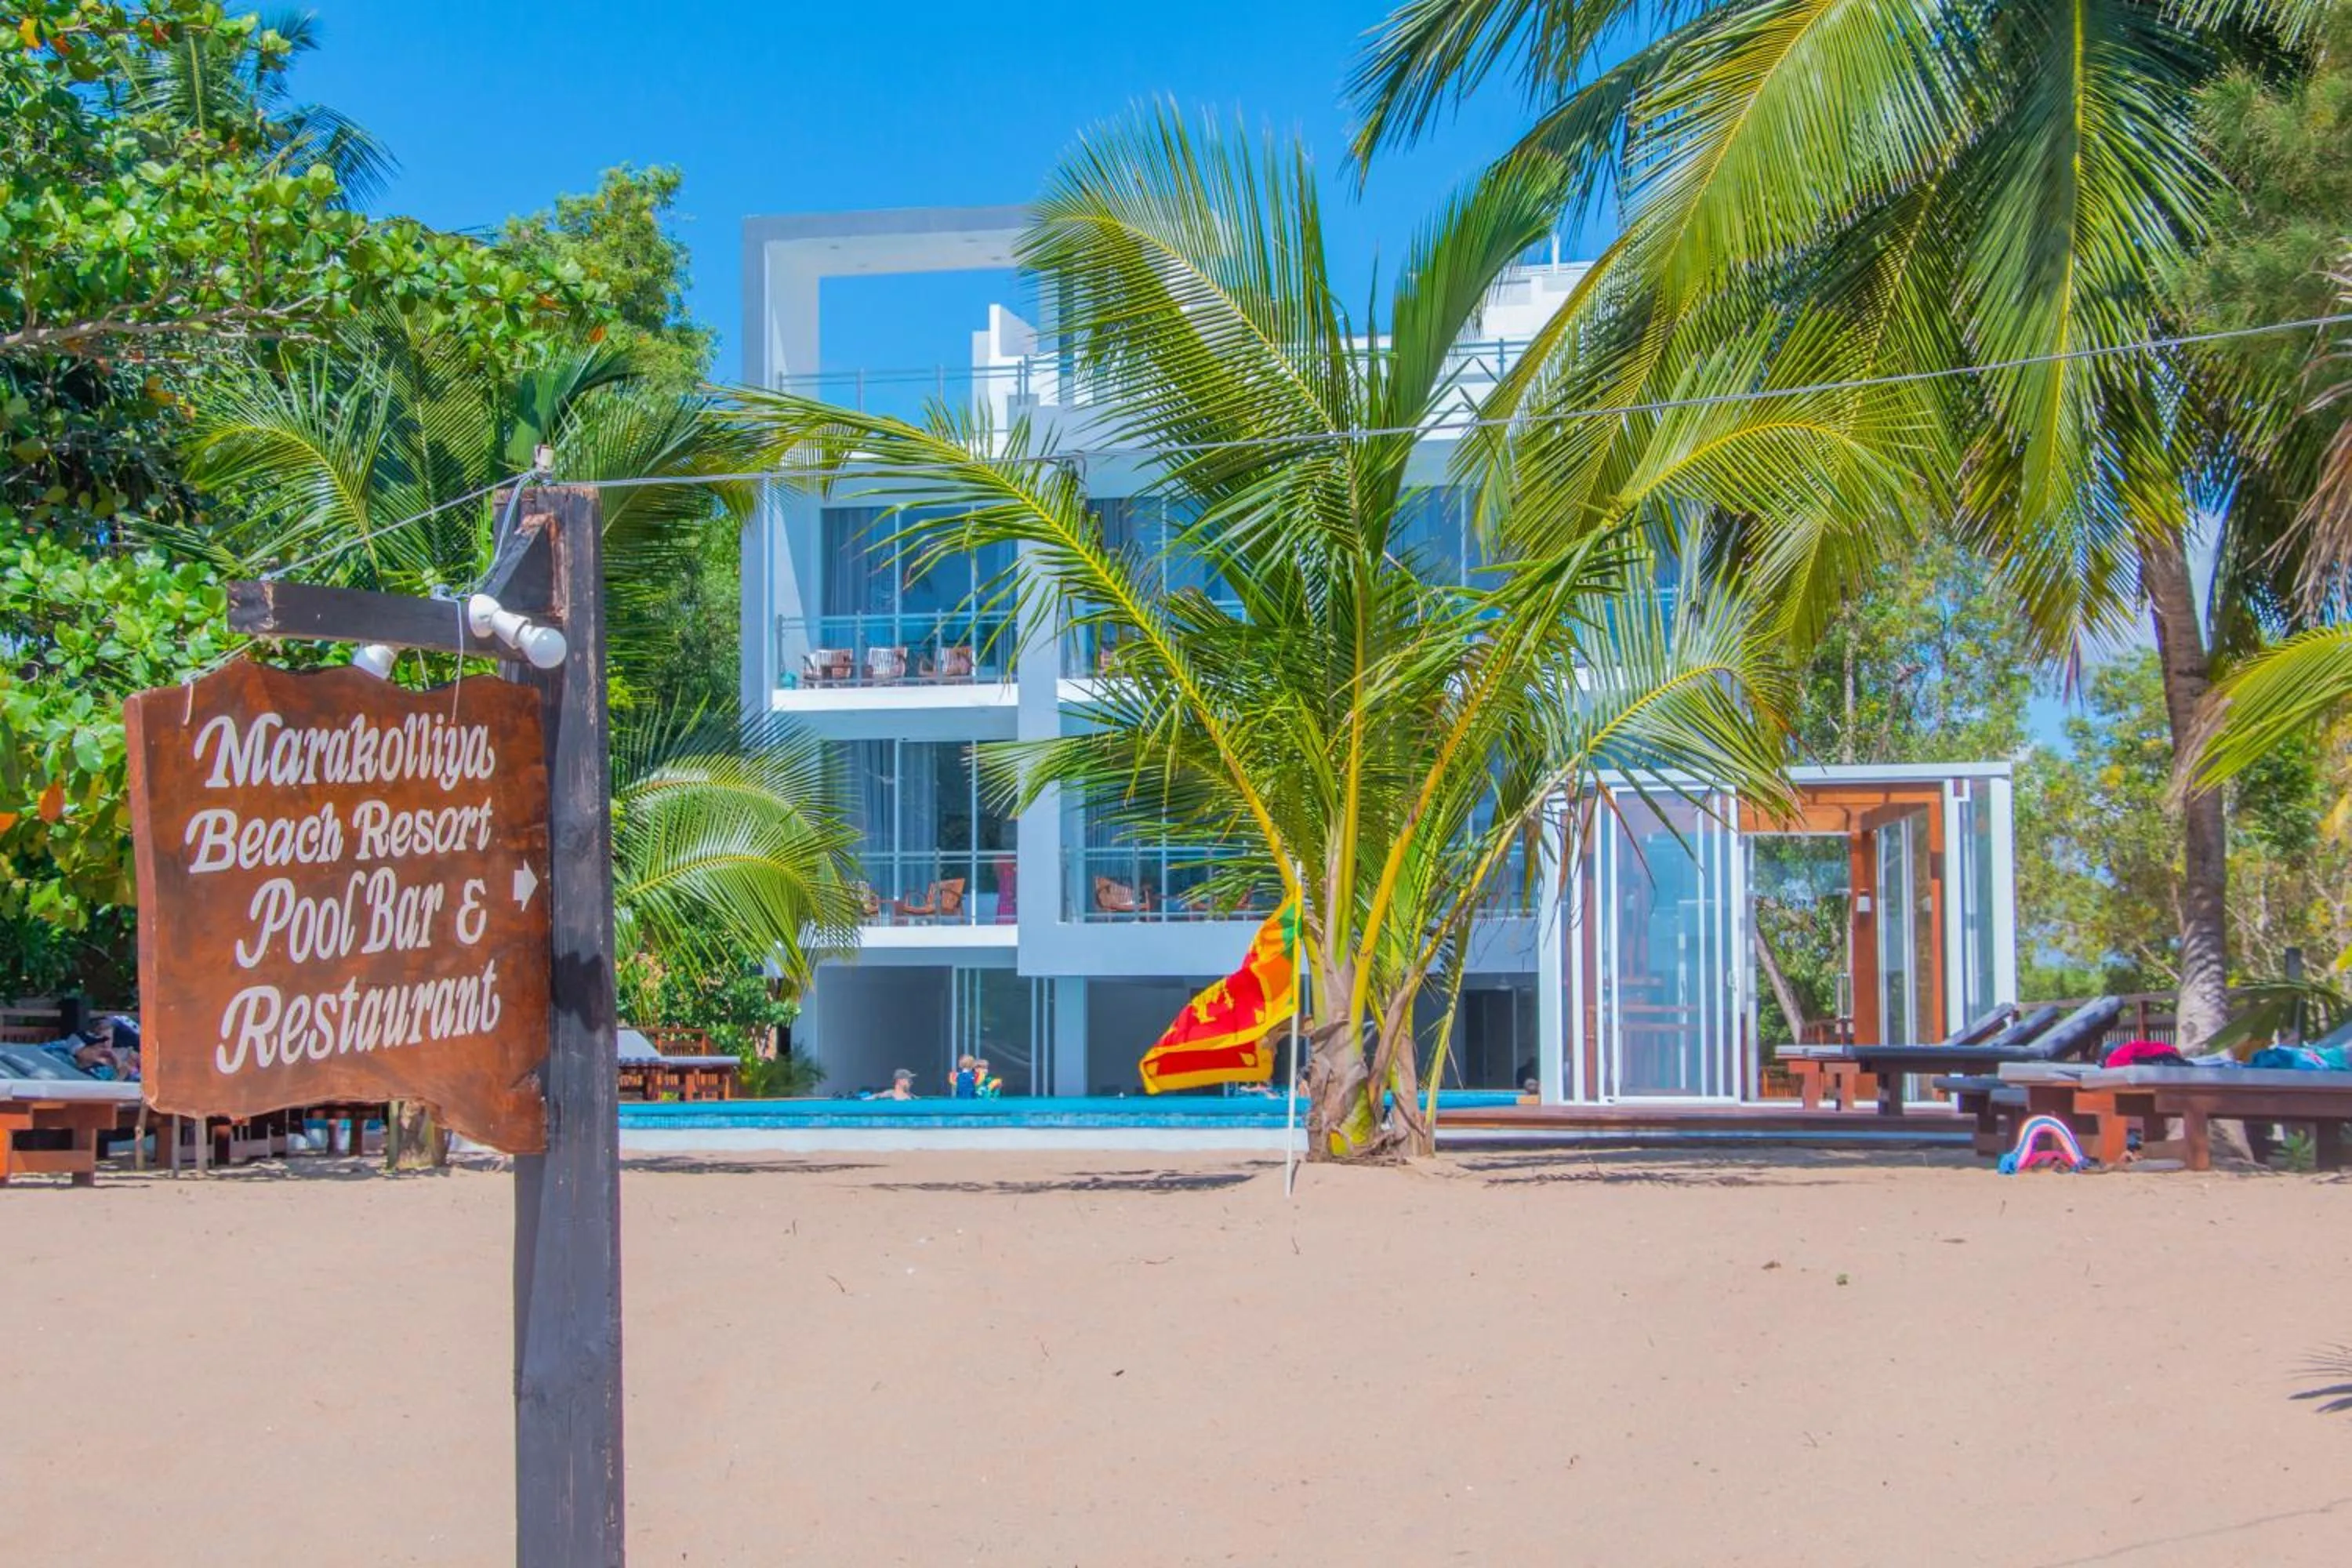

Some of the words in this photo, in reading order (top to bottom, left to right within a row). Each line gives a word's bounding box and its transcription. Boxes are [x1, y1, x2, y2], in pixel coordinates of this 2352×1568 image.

[193, 712, 495, 791] Marakolliya
[184, 801, 344, 873] Beach
[352, 797, 493, 862] Resort
[234, 870, 365, 969] Pool
[361, 866, 445, 955] Bar
[456, 878, 488, 946] &
[215, 959, 501, 1075] Restaurant
